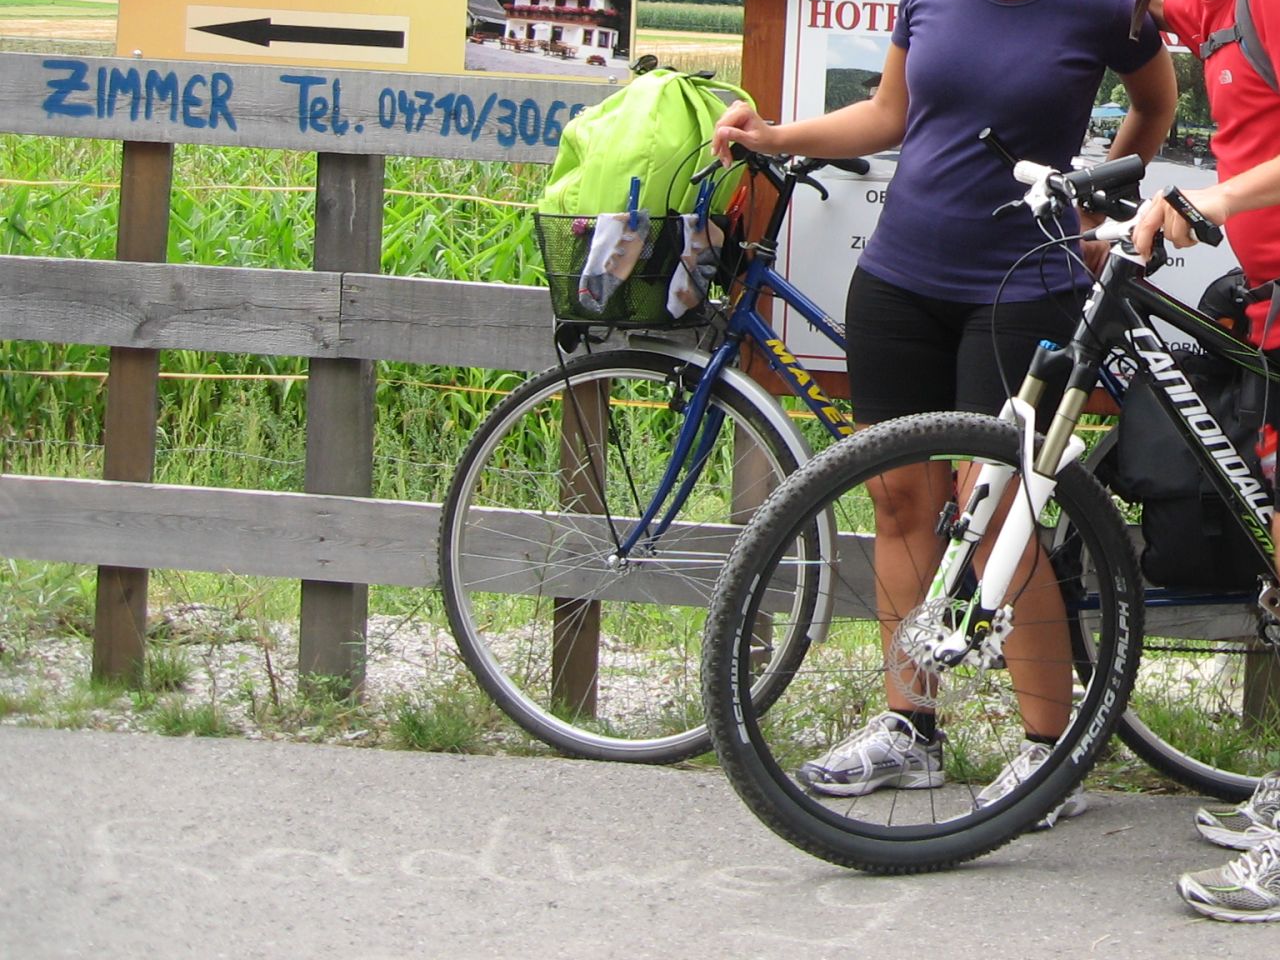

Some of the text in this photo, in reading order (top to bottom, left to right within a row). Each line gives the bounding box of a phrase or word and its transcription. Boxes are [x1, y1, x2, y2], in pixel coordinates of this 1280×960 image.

[42, 60, 237, 131] ZIMMER
[280, 75, 363, 136] Tel.
[1071, 601, 1129, 764] RACING RALPH
